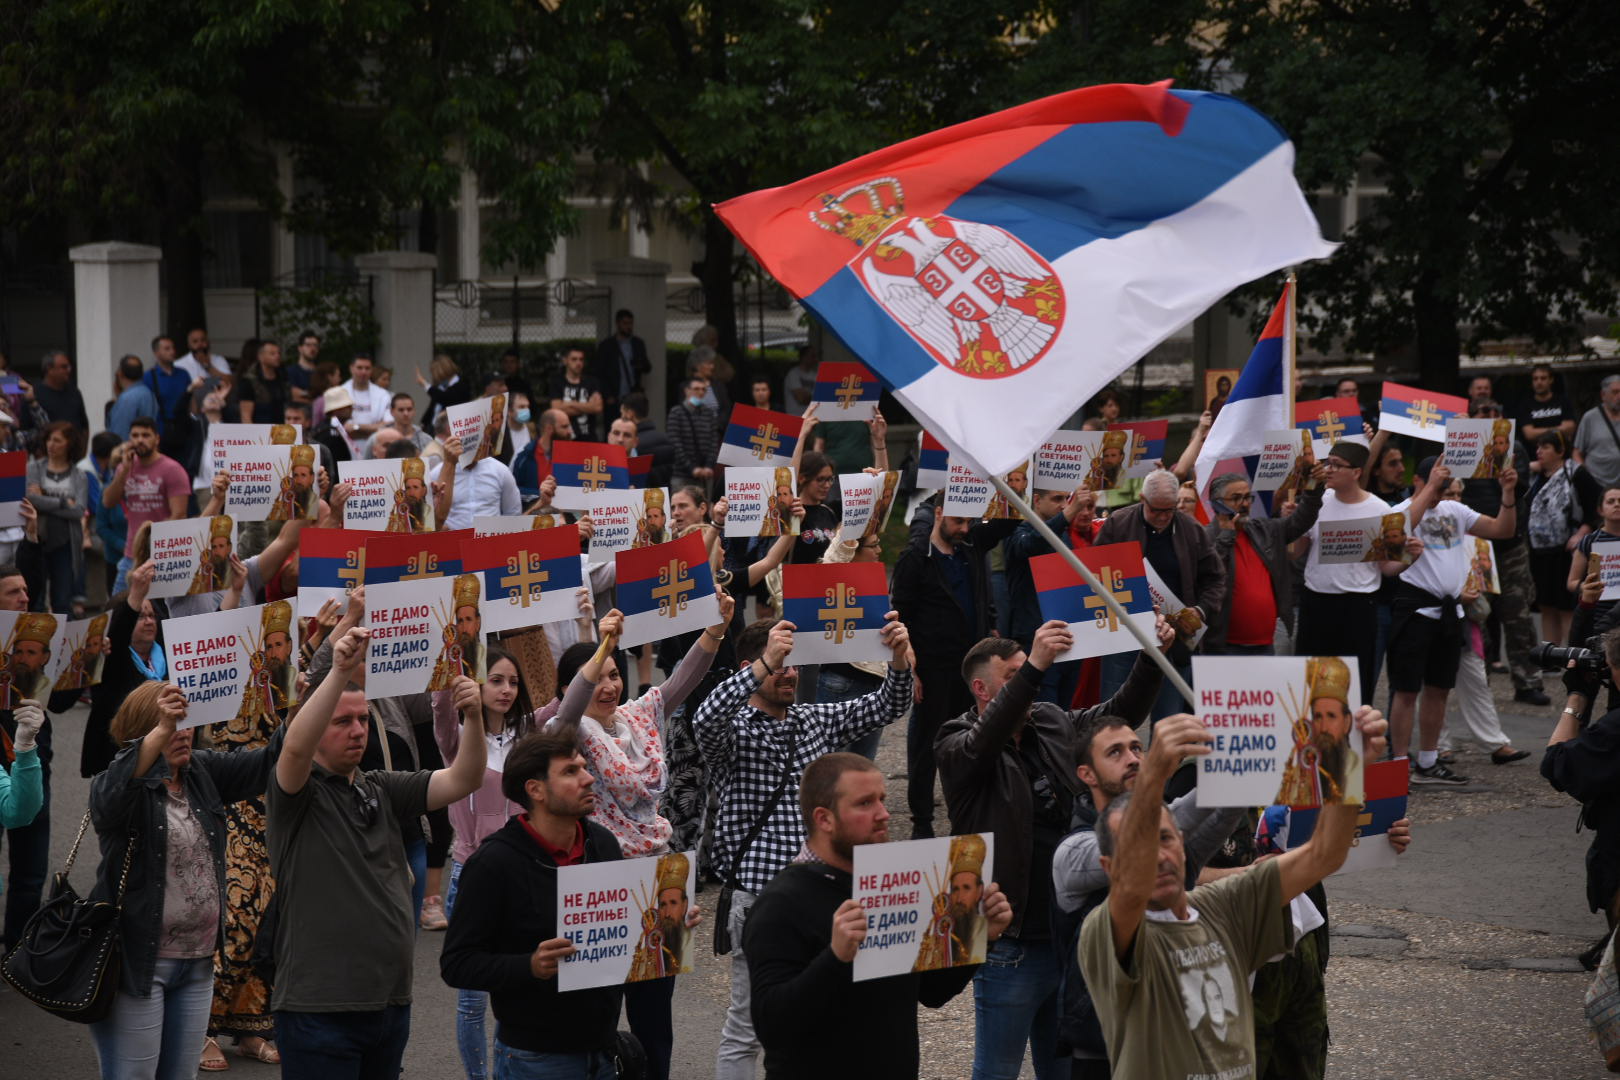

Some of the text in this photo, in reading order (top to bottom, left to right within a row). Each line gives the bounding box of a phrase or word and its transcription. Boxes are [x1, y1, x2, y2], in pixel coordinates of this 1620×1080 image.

[453, 416, 481, 428] НЕ ДАМО
[1458, 432, 1478, 440] ДАМО
[1055, 444, 1083, 452] ДАМО
[1273, 444, 1291, 452] ДАМО
[1040, 453, 1081, 461] СВЕТИЊЕ!
[1456, 450, 1476, 458] ДАМО
[230, 462, 272, 472] НЕ ДАМО
[1053, 462, 1081, 470] ДАМО
[1270, 462, 1288, 470] ДАМО
[230, 474, 272, 482] СВЕТИЊЕ!
[1039, 470, 1080, 479] ВЛАДИКУ!
[359, 476, 384, 486] ДАМО
[230, 485, 271, 495] НЕ ДАМО
[351, 488, 385, 496] ВЕТИЊЕ!
[740, 483, 760, 492] ДАМО
[844, 488, 872, 497] НЕ ДАМО
[962, 486, 987, 495] ДАМО
[229, 497, 270, 505] ВЛАДИКУ!
[347, 499, 385, 509] НЕ ДАМО
[593, 506, 628, 517] НЕ ДАМО
[740, 504, 760, 512] ДАМО
[854, 508, 869, 517] ДАМО
[347, 510, 385, 520] ВЛАДИКУ!
[593, 517, 629, 526] СВЕТИЊЕ!
[594, 528, 629, 538] НЕ ДАМО
[154, 536, 192, 549] НЕ ДАМО
[593, 539, 628, 547] ВЛАДИКУ!
[154, 549, 192, 559] СВЕТИЊЕ!
[154, 560, 192, 572] НЕ ДАМО
[371, 605, 429, 624] НЕ ДАМО
[372, 623, 429, 639] СВЕТИЊЕ!
[173, 635, 236, 656] НЕ ДАМО
[372, 639, 429, 658] НЕ ДАМО
[175, 652, 236, 671] СВЕТИЊЕ!
[371, 657, 428, 673] ВЛАДИКУ!
[178, 668, 238, 688] НЕ ДАМО
[1202, 690, 1274, 710] НЕ ДАМО
[1203, 714, 1275, 727] СВЕТИЊЕ!
[1230, 735, 1276, 755] ДАМО
[1204, 758, 1275, 775] ВЛАДИКУ!
[859, 871, 921, 892] НЕ ДАМО
[564, 888, 628, 908] НЕ ДАМО
[860, 890, 919, 908] СВЕТИЊЕ!
[564, 907, 628, 925] СВЕТИЊЕ!
[868, 910, 918, 931] Е ДАМО
[564, 925, 628, 946] НЕ ДАМО
